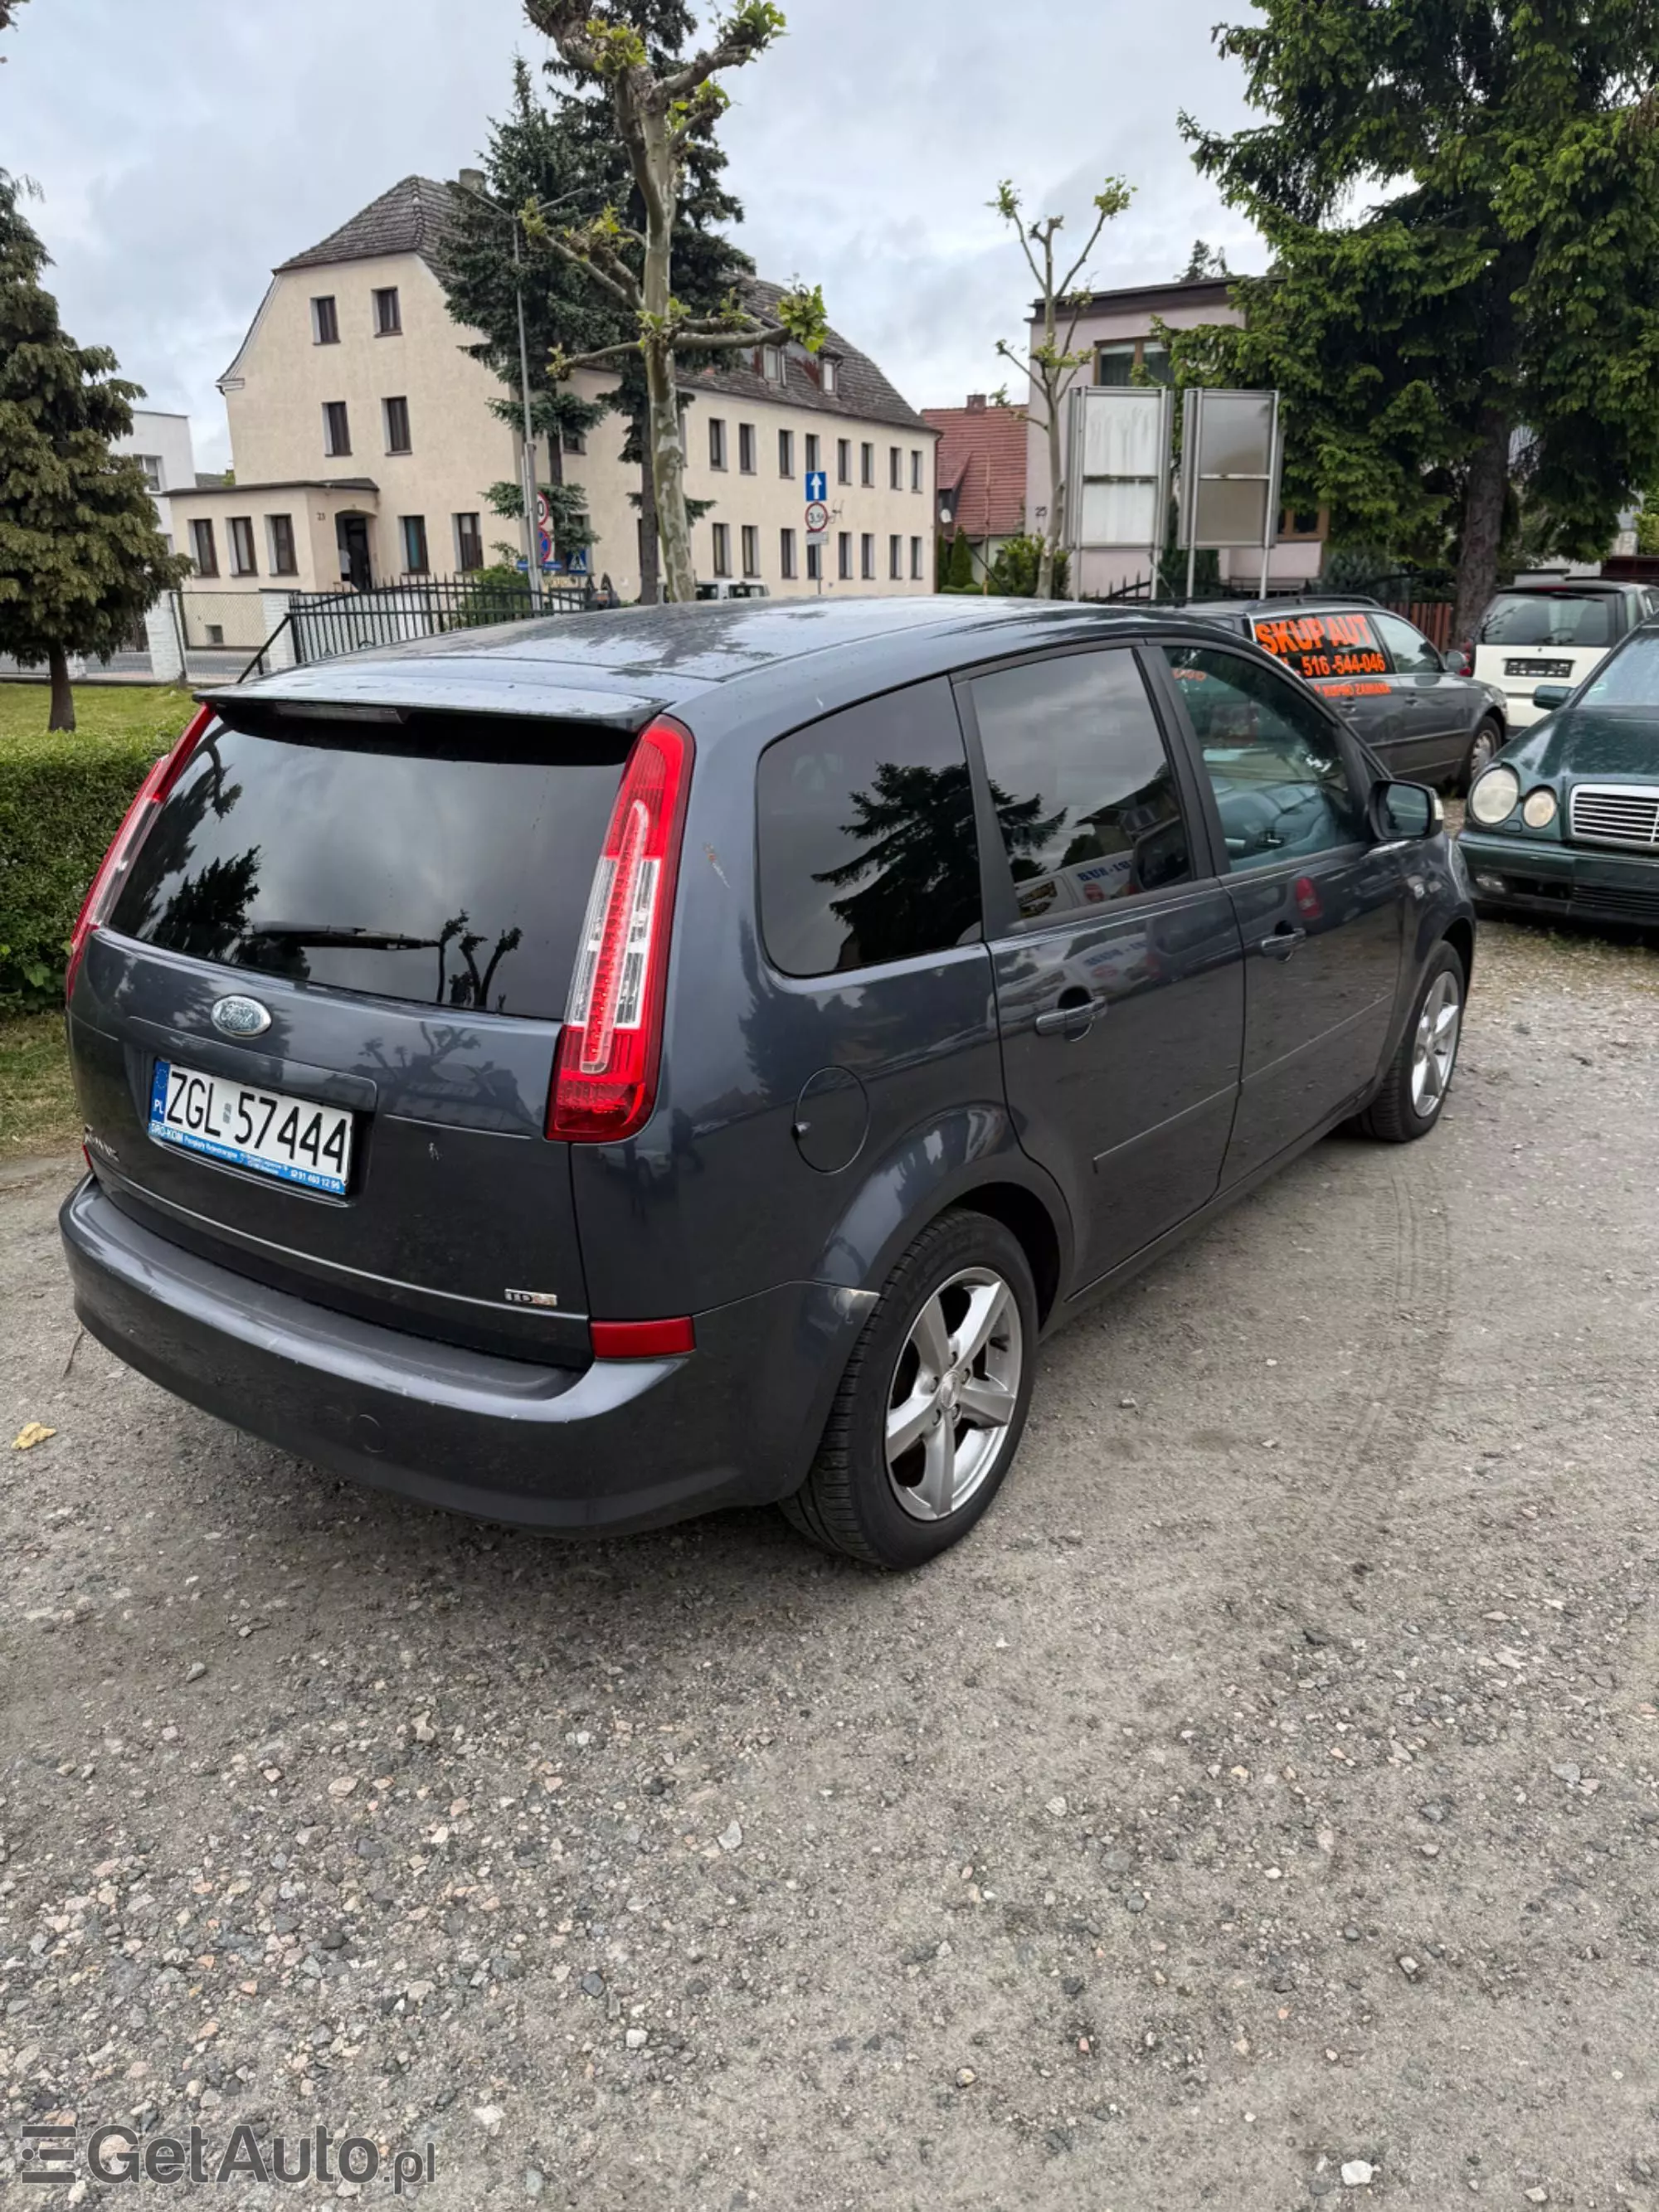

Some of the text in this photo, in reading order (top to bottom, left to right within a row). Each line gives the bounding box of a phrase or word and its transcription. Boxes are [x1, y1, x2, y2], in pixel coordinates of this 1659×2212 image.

[1255, 614, 1371, 655] SKUP AUT
[153, 1099, 163, 1115] PL
[167, 1071, 347, 1174] ZGL 57444
